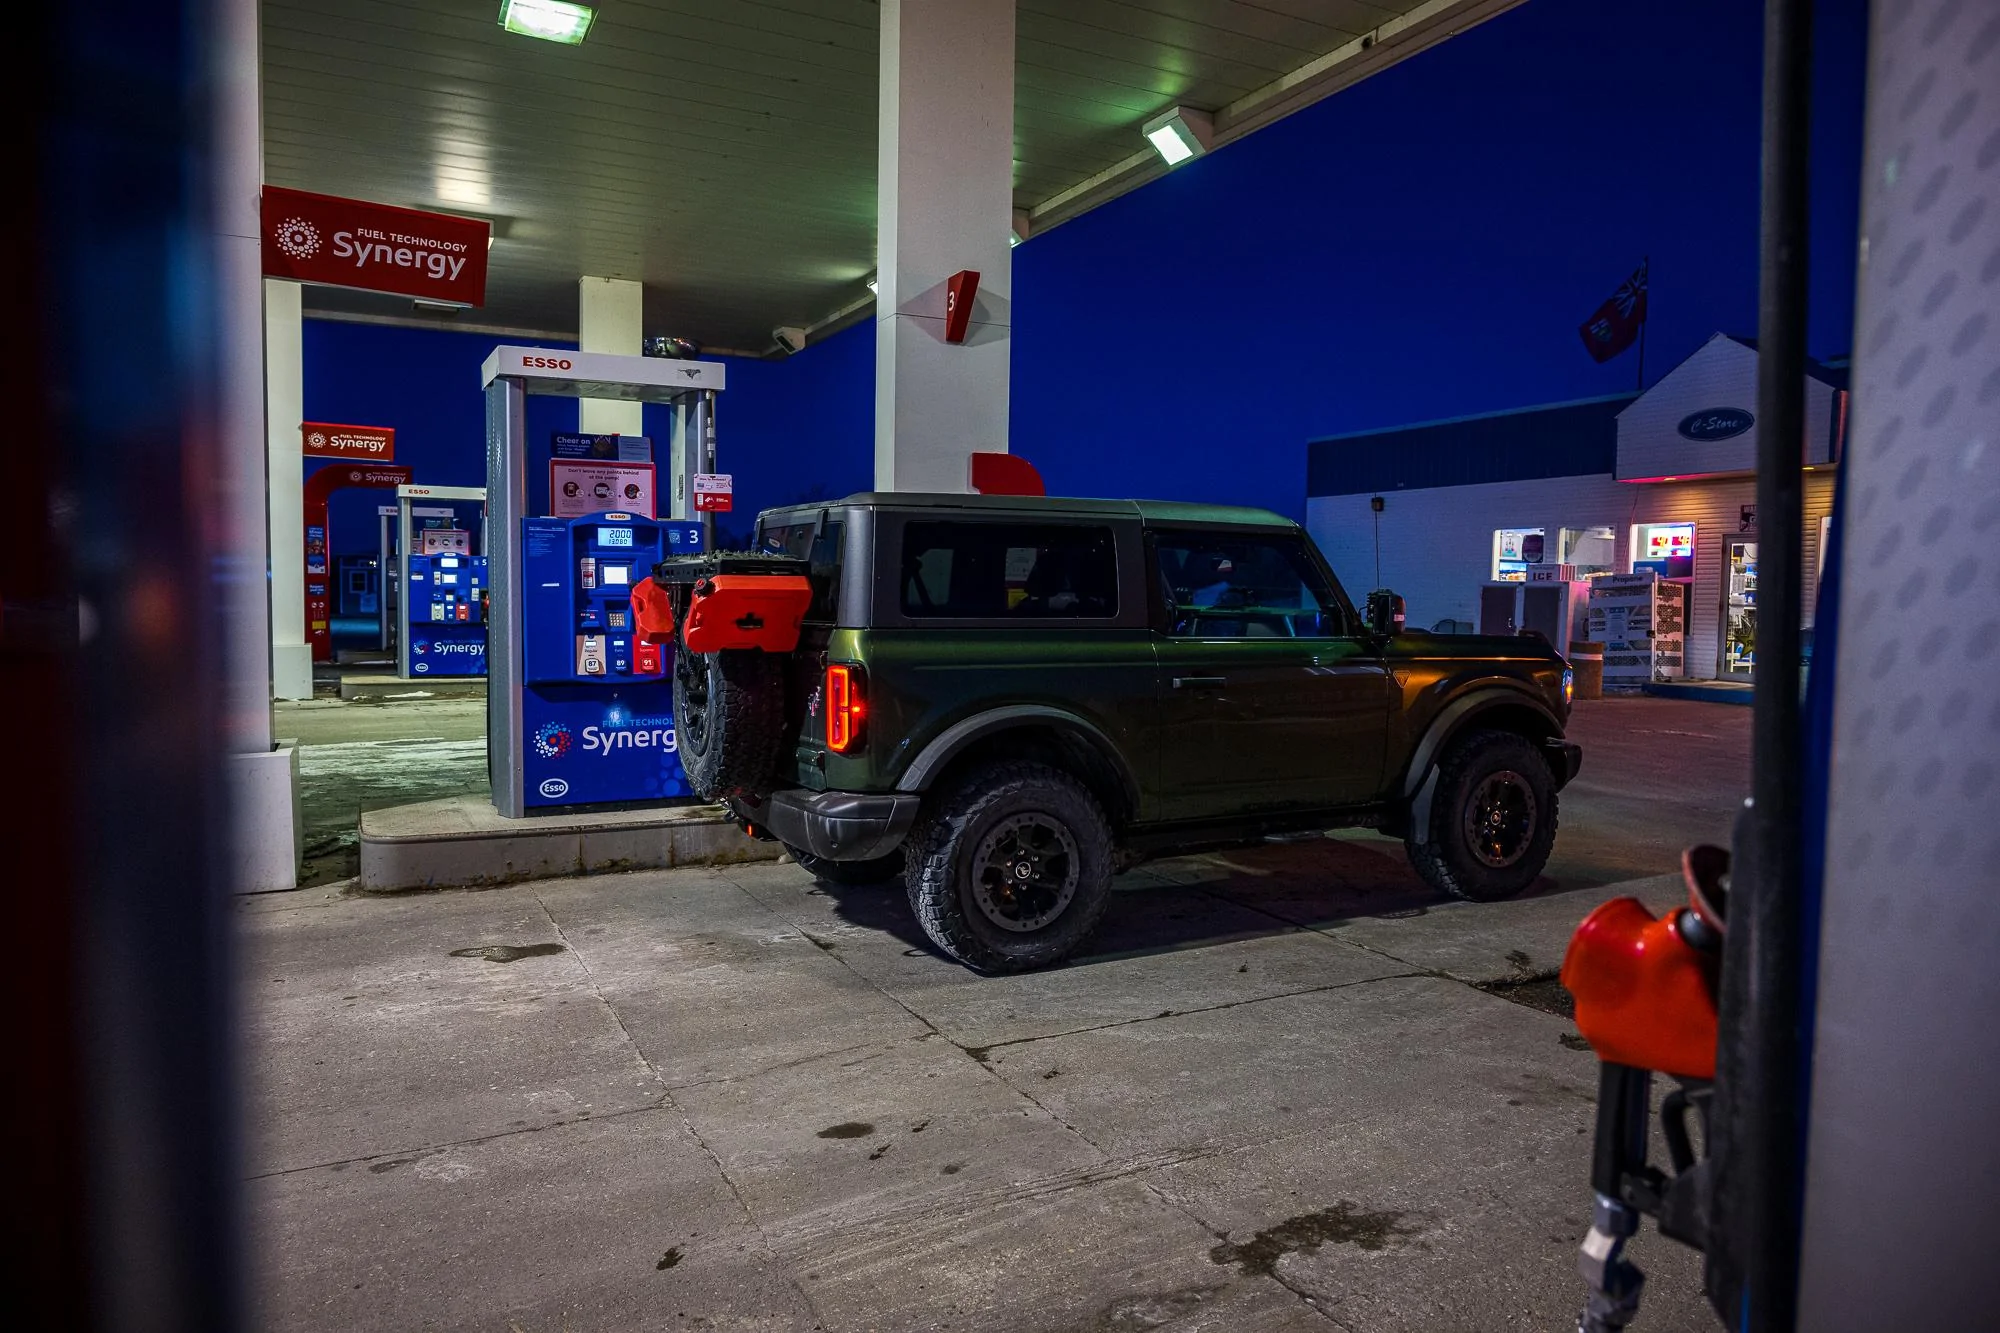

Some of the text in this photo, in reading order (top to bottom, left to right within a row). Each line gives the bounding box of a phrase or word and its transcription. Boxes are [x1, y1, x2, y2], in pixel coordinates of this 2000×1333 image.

[357, 227, 468, 253] FUEL TECHNOLOGY
[333, 231, 467, 281] Synergy
[948, 291, 955, 311] 3
[522, 356, 572, 370] ESSO
[330, 436, 386, 453] Synergy
[556, 436, 579, 444] Cheer
[365, 473, 406, 484] Synergy
[689, 529, 699, 544] 3
[1533, 572, 1553, 581] ICE
[1612, 575, 1643, 584] Propane
[434, 641, 485, 656] Synergy
[602, 717, 675, 728] FUEL TECHNOL
[582, 726, 678, 756] Synerg
[544, 783, 565, 792] Esso
